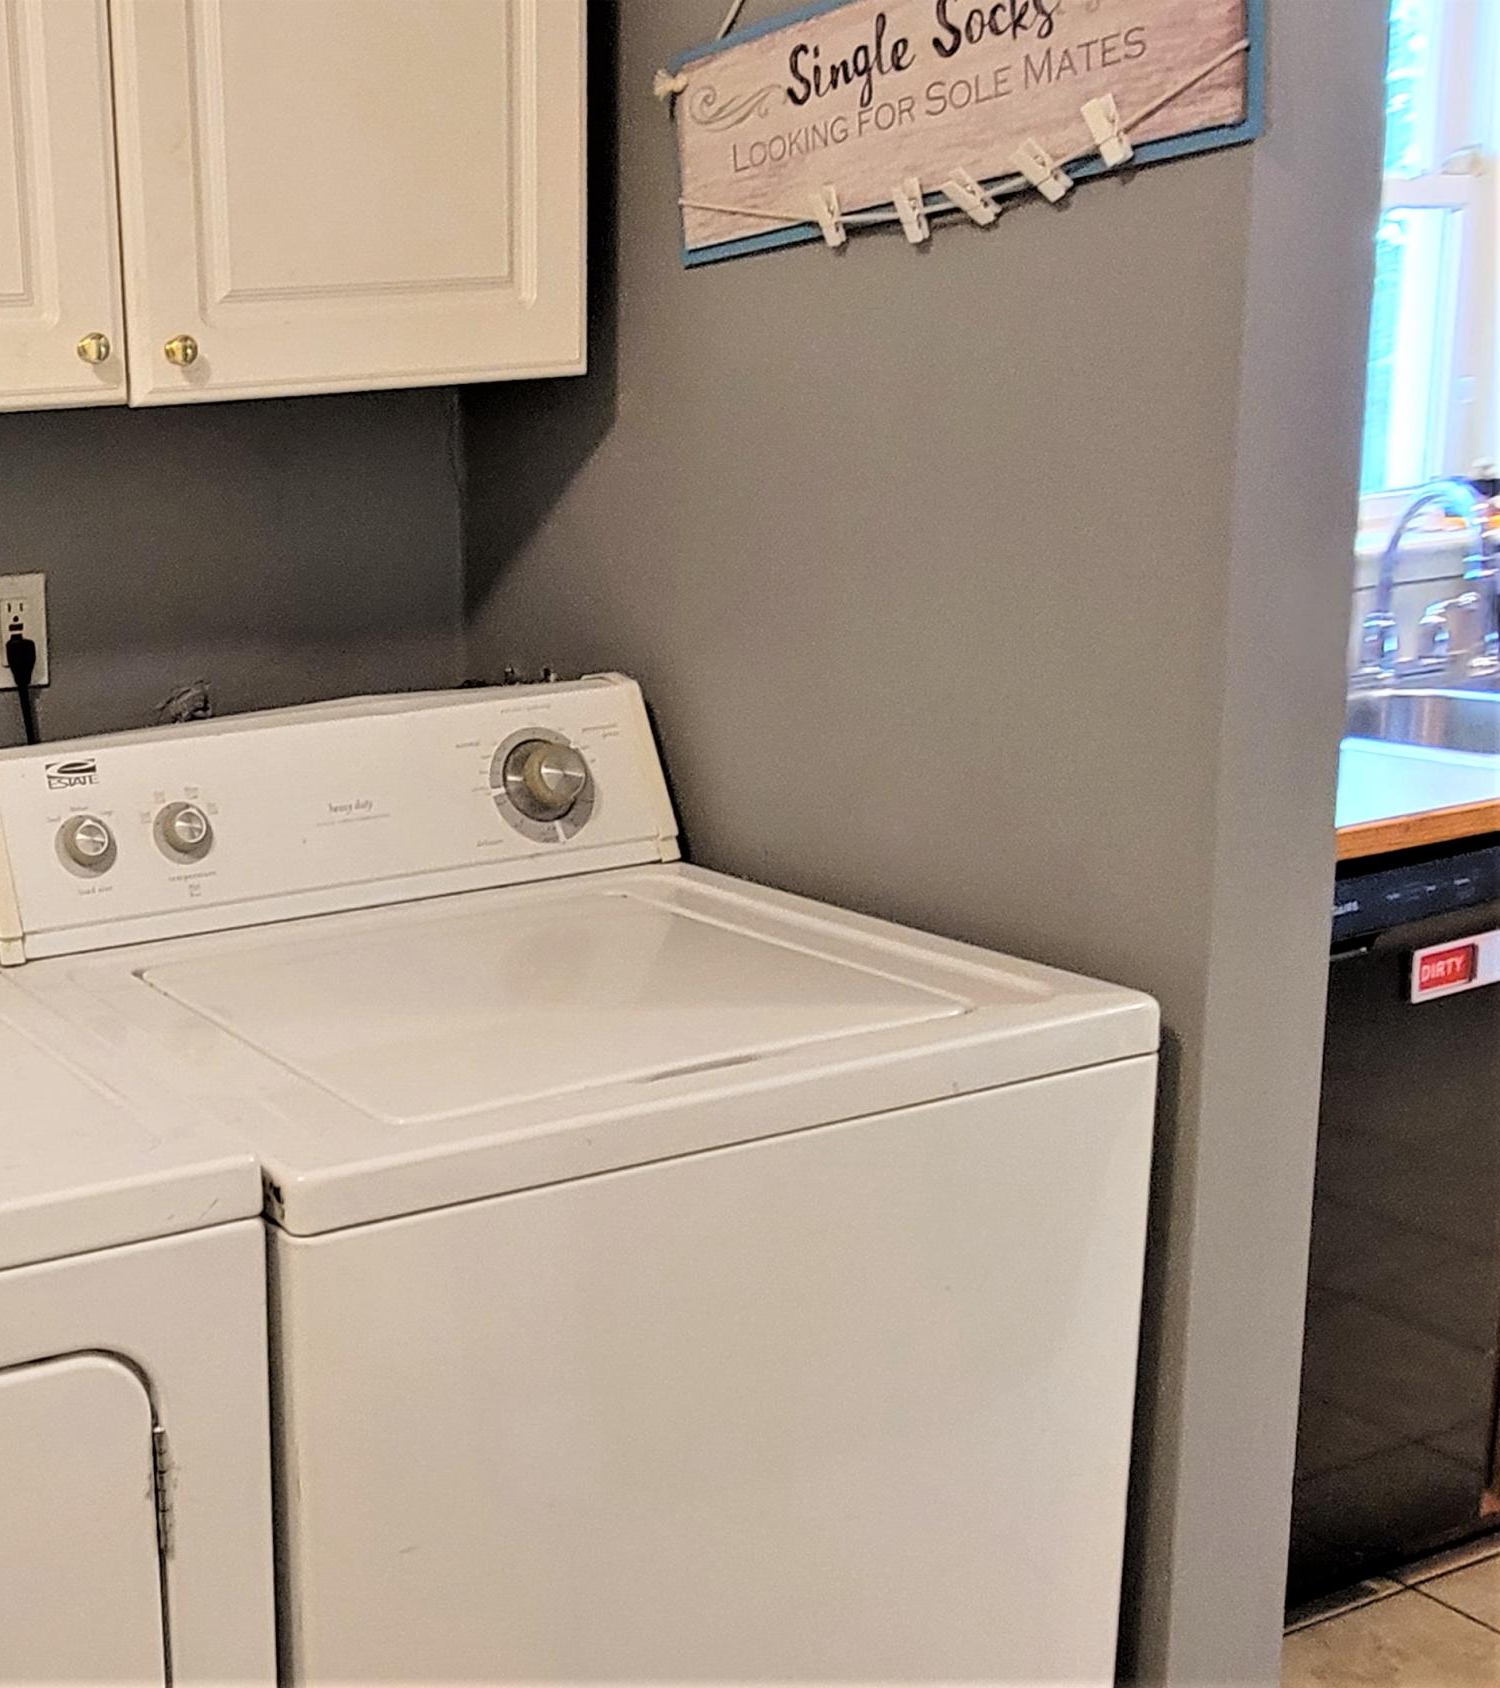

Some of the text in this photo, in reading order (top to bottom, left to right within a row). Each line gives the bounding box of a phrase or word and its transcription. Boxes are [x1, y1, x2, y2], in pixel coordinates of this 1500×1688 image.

[786, 0, 1057, 108] Single Socks
[732, 26, 1148, 173] LOOKING FOR SOLE MATES
[47, 774, 101, 790] ESTATE
[1420, 956, 1466, 982] DIRTY
